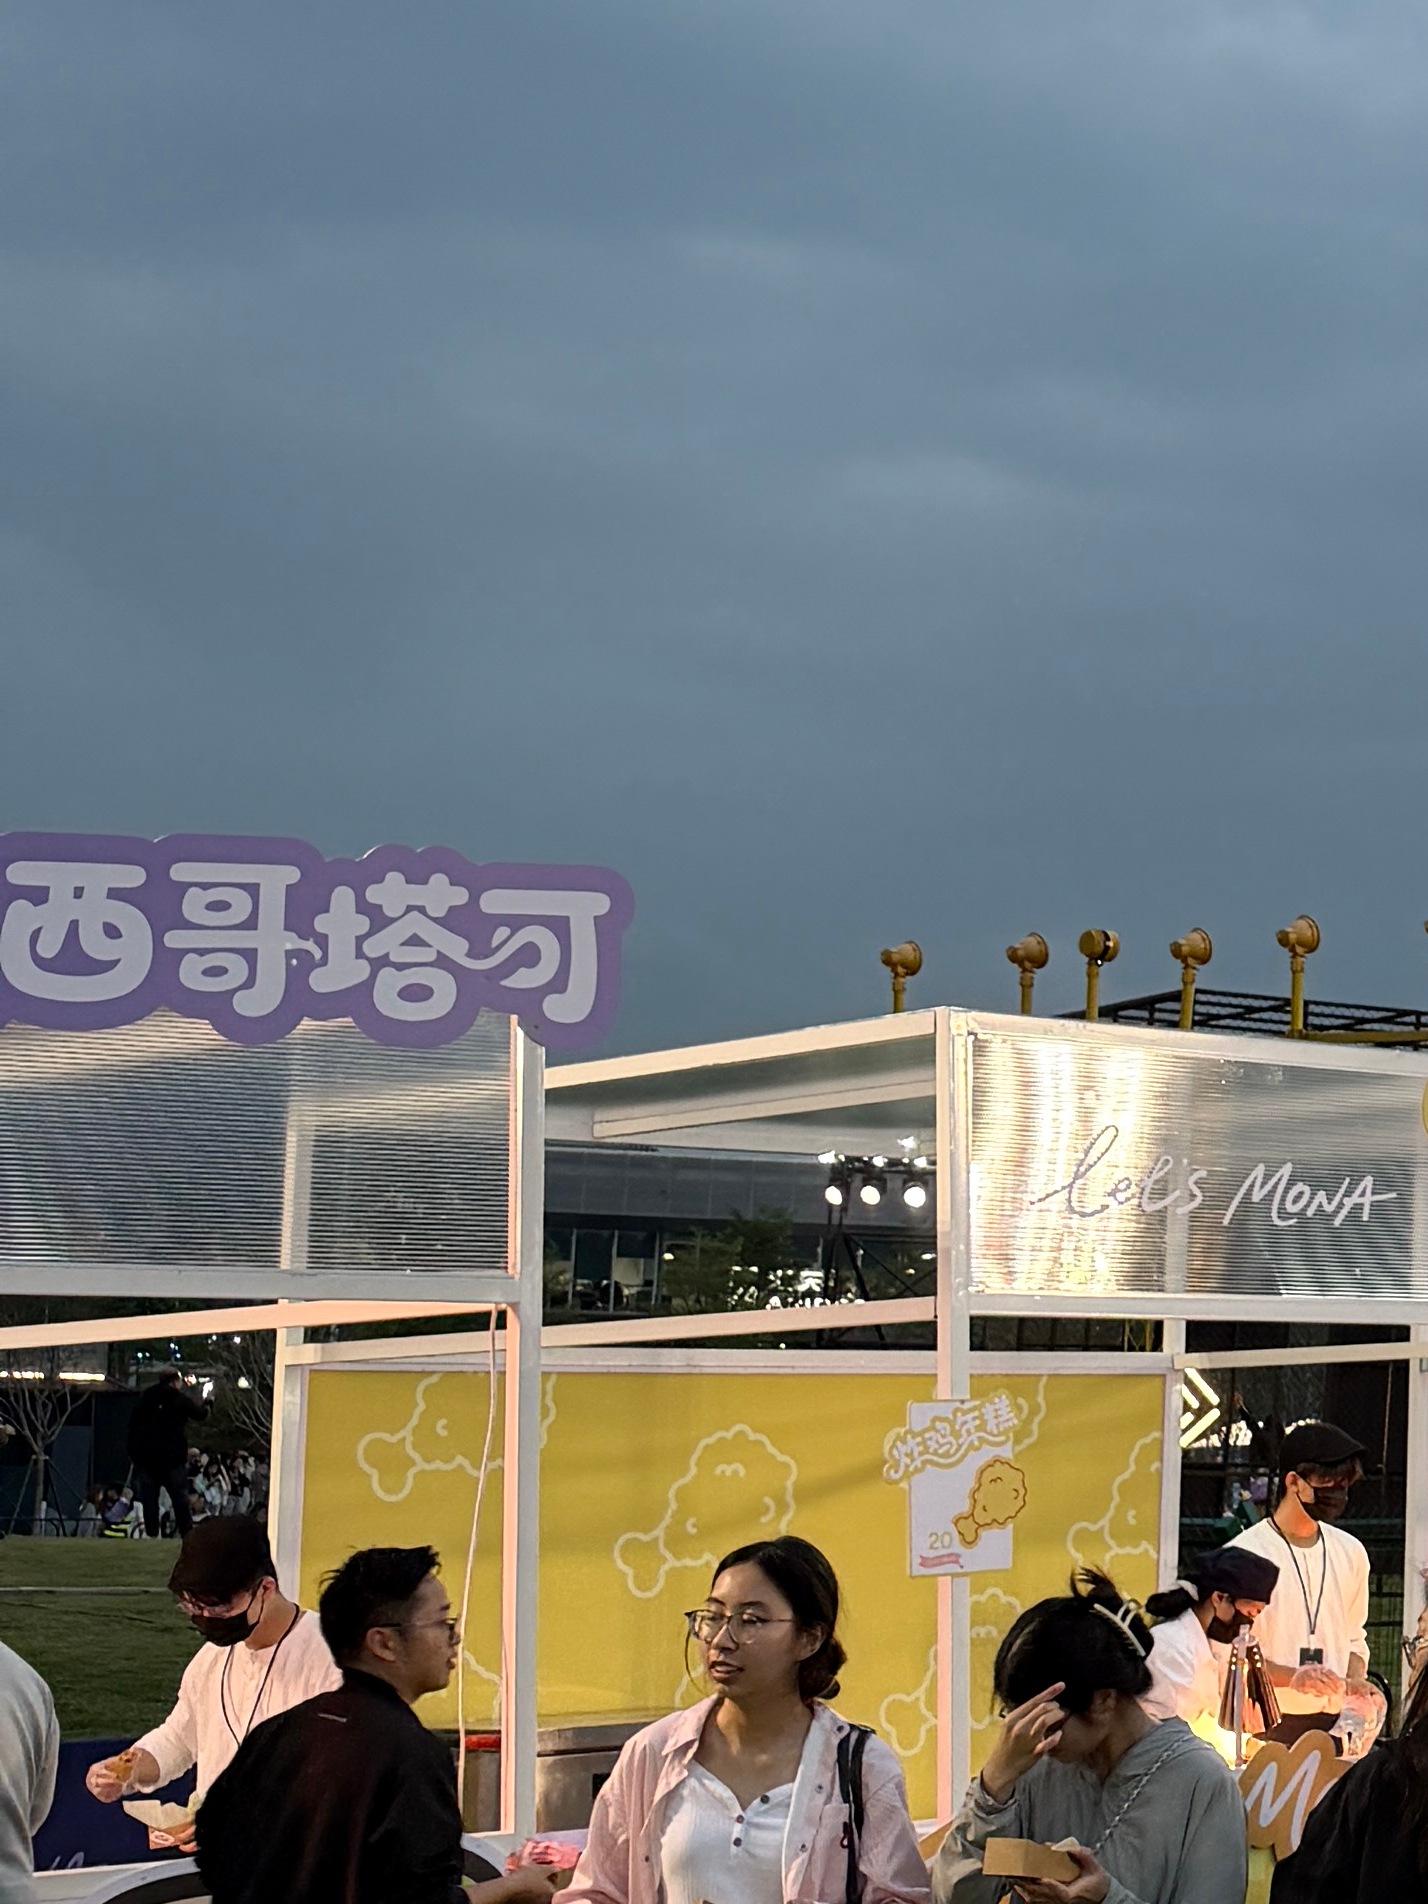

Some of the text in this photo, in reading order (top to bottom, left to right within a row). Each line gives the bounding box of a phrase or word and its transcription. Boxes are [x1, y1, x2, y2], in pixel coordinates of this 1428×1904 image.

[0, 860, 612, 1024] 西哥塔可
[888, 1393, 1019, 1480] 炸鸡年糕
[928, 1529, 953, 1550] 20
